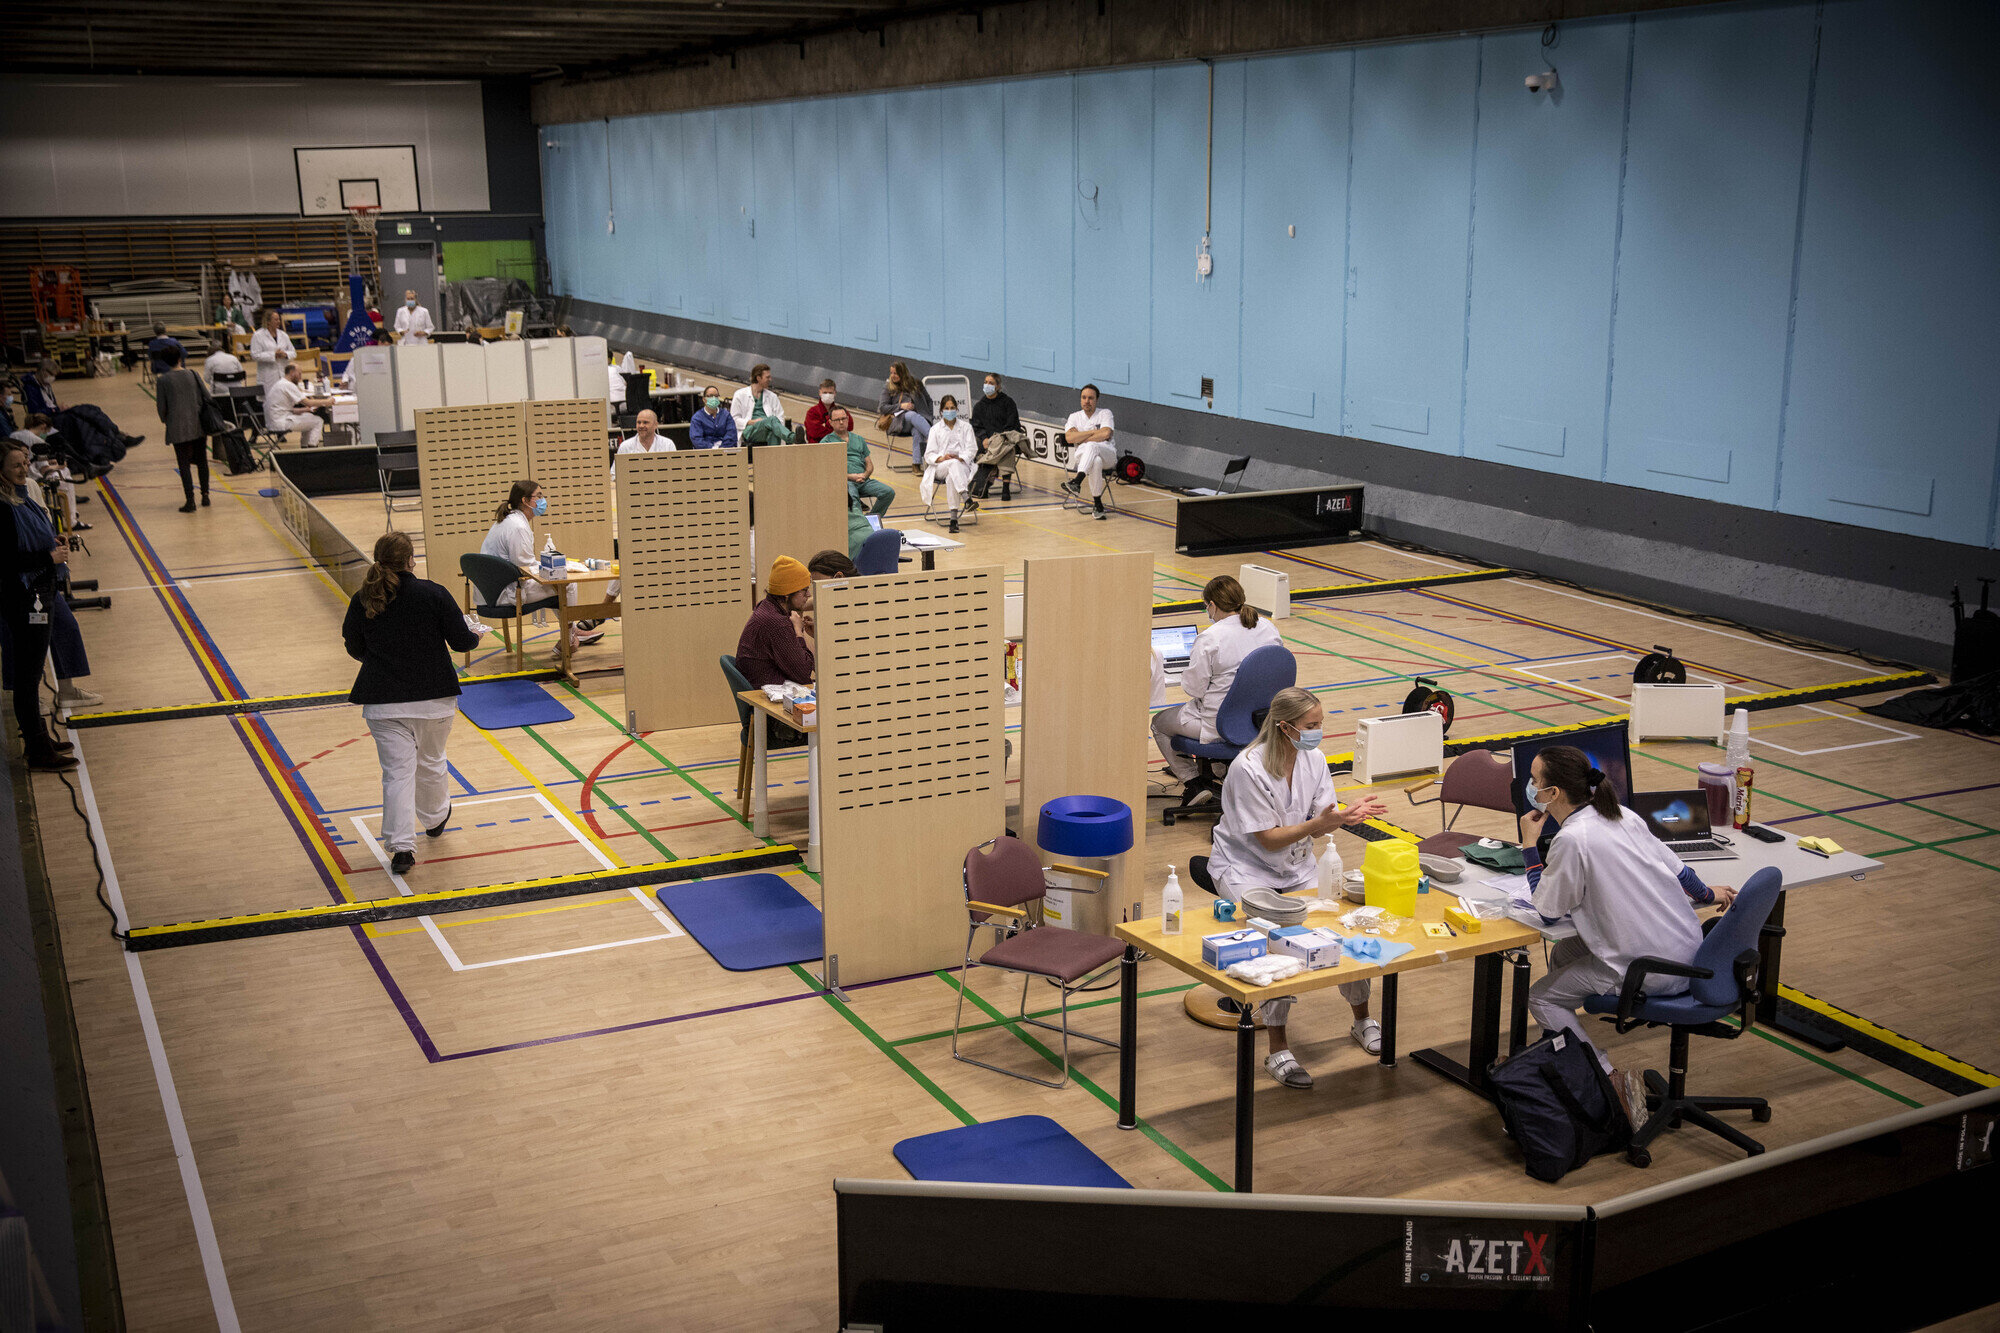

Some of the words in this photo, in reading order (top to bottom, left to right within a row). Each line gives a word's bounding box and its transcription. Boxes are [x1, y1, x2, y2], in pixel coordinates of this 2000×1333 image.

[609, 435, 623, 448] ETX
[1326, 495, 1351, 510] AZETX
[1736, 788, 1744, 811] Marie
[1405, 1220, 1413, 1251] POLAND
[1405, 1252, 1412, 1261] IN
[1441, 1230, 1548, 1275] AZETX
[1404, 1262, 1412, 1283] MADE
